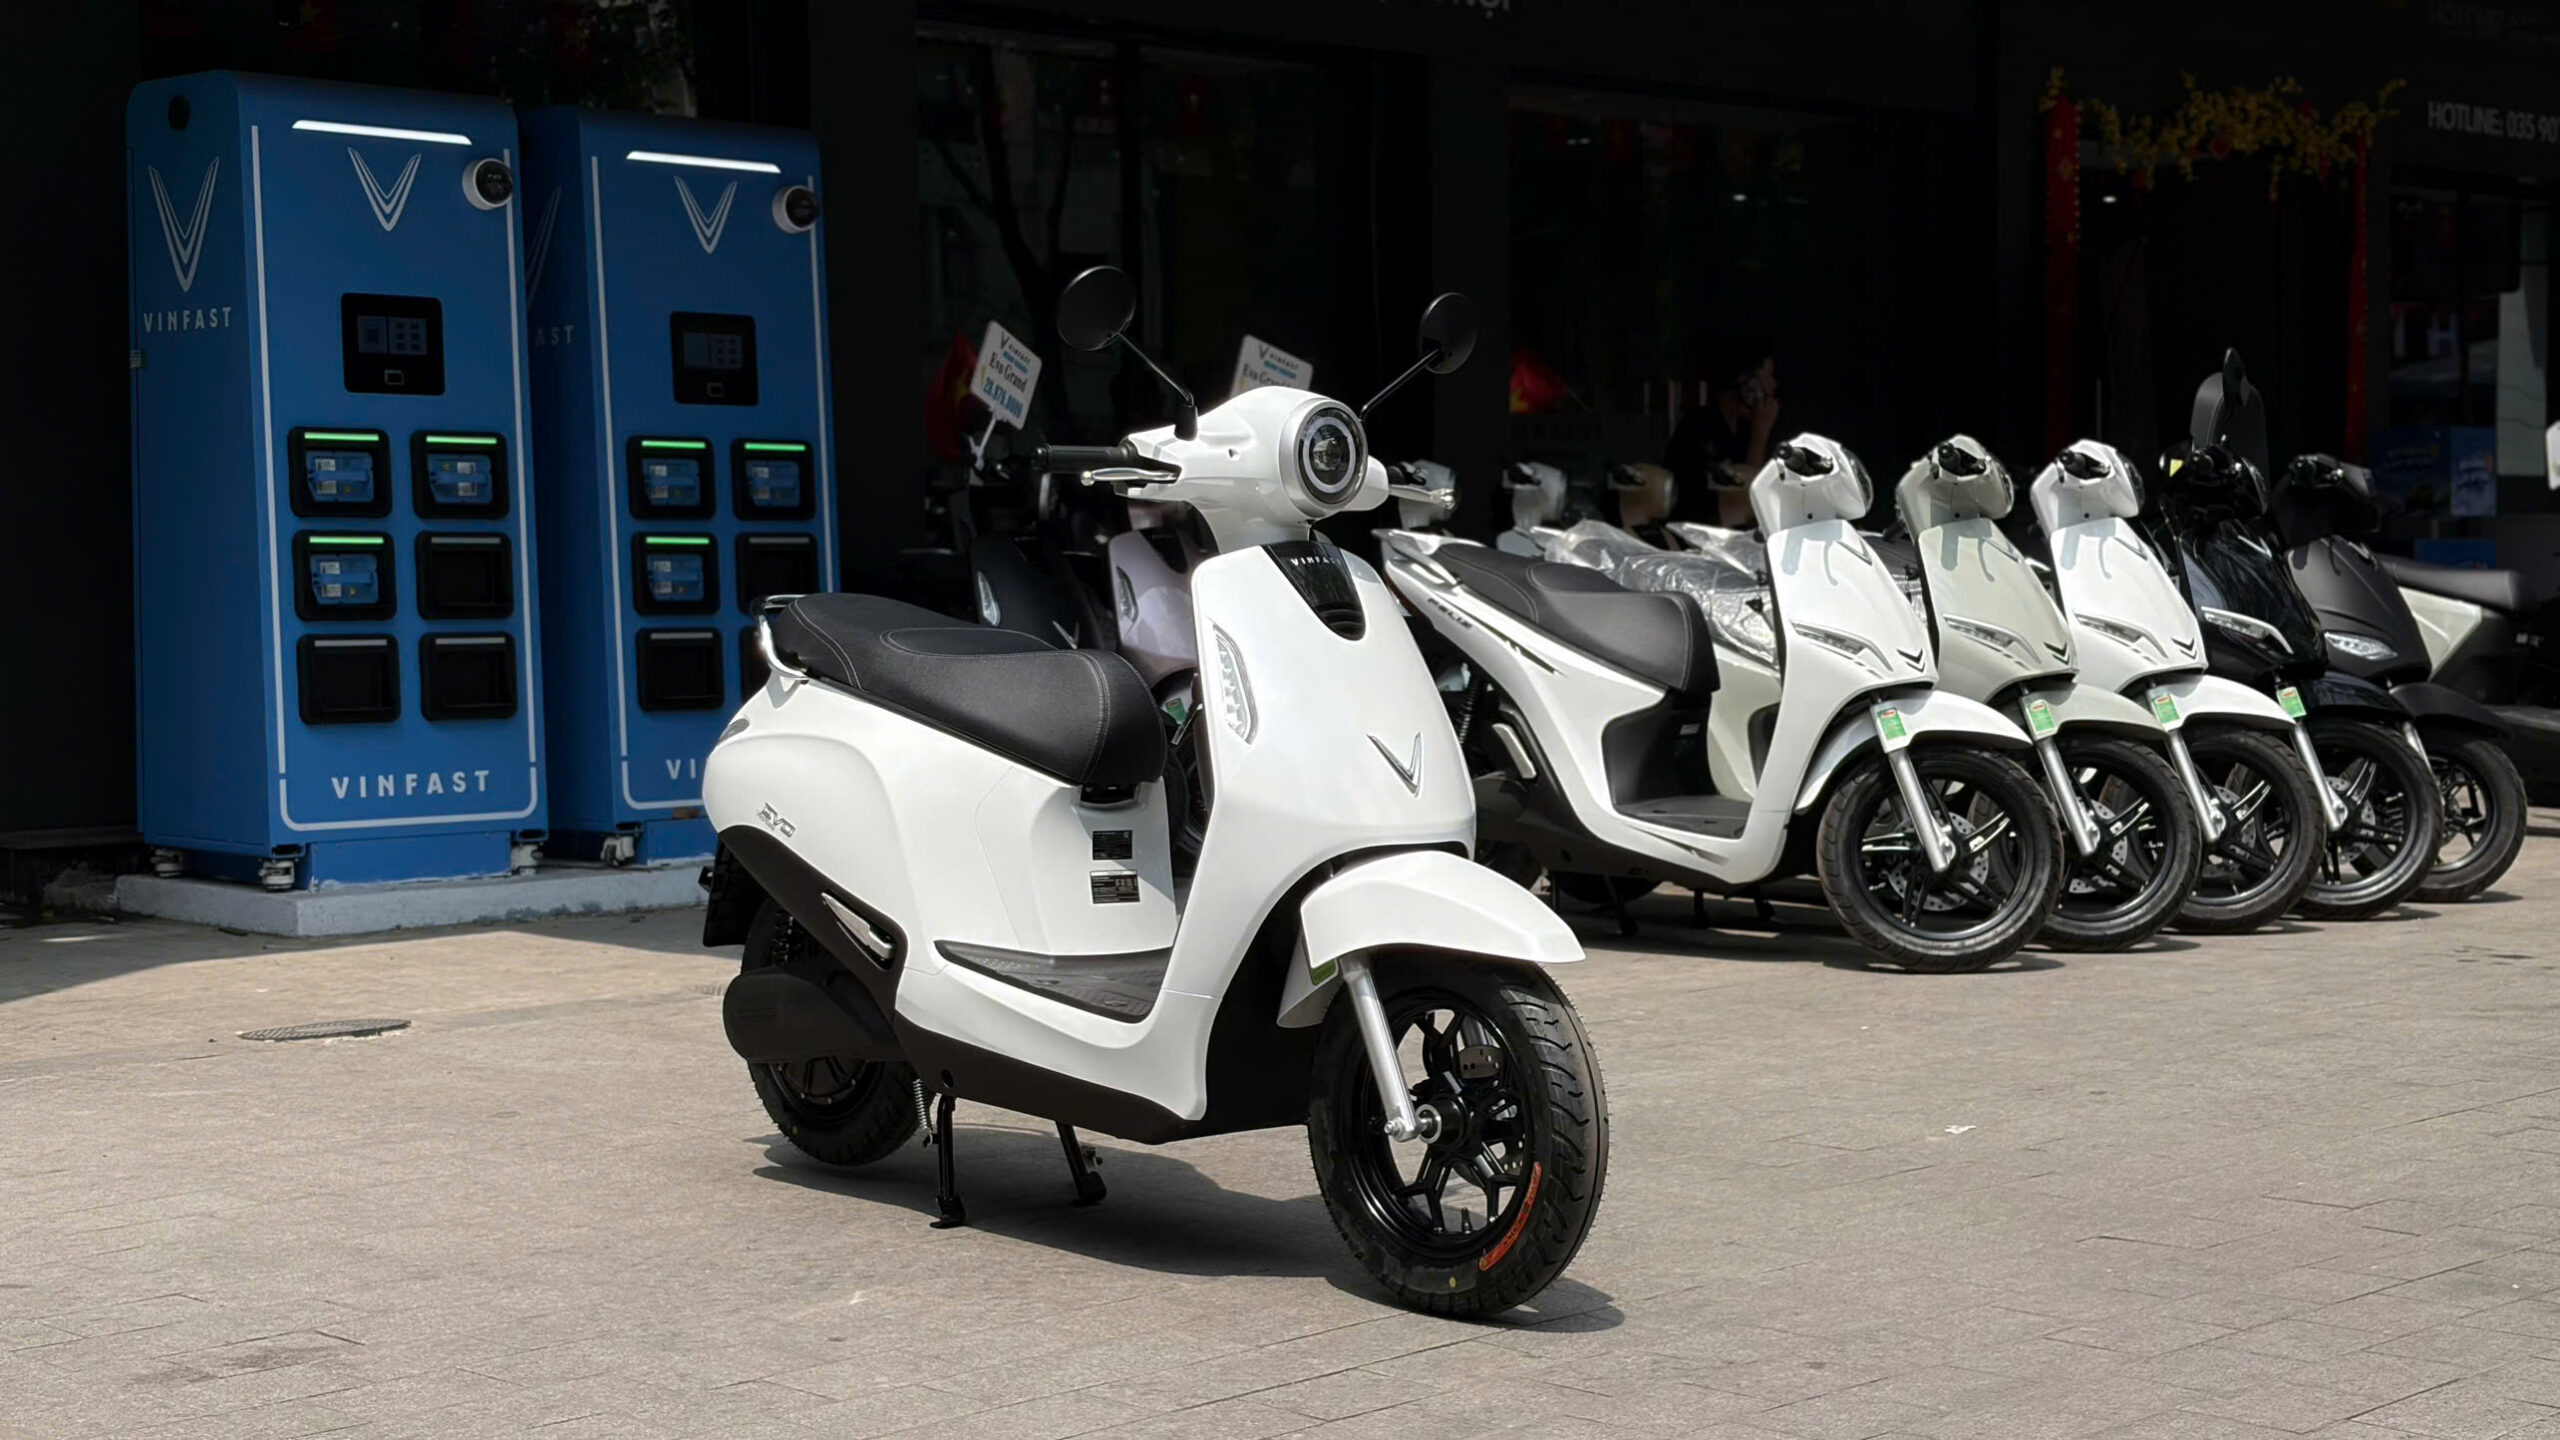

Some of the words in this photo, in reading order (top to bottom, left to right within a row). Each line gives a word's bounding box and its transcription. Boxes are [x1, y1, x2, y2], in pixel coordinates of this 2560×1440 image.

[2506, 110, 2536, 140] 035
[142, 306, 233, 333] VINFAST
[989, 352, 1004, 374] Evo
[1005, 364, 1028, 393] Grand
[331, 769, 490, 800] VINFAST
[761, 801, 796, 838] EVO
